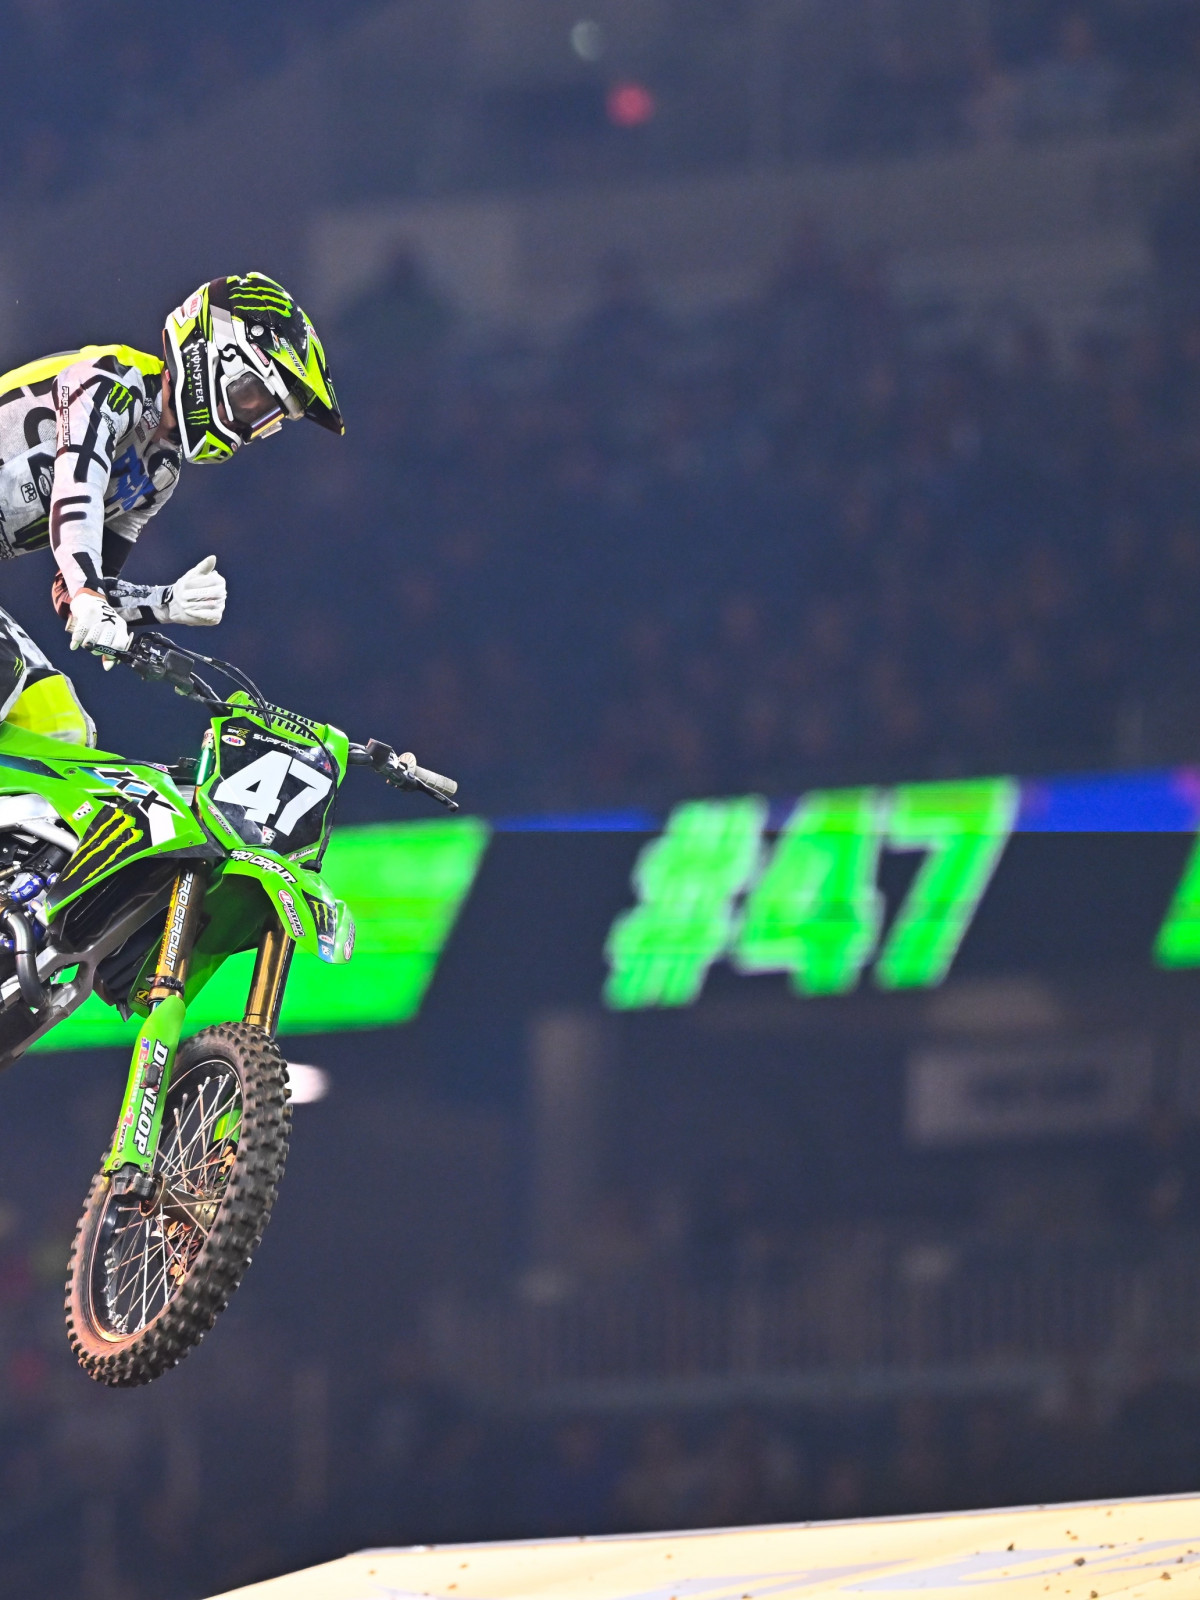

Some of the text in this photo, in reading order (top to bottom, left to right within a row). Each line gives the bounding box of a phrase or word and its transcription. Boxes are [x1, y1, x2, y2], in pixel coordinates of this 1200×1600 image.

[189, 297, 199, 315] BELL
[189, 345, 205, 405] MONSTER
[61, 385, 71, 447] PRO CIRCUIT
[252, 733, 316, 762] SUPERCROSS
[213, 750, 333, 837] 47
[179, 872, 194, 906] PRO
[231, 850, 297, 883] PRO CIRCUIT
[603, 776, 1021, 1010] #47
[165, 905, 187, 972] CIRCUIT
[133, 1039, 169, 1156] DNLOP
